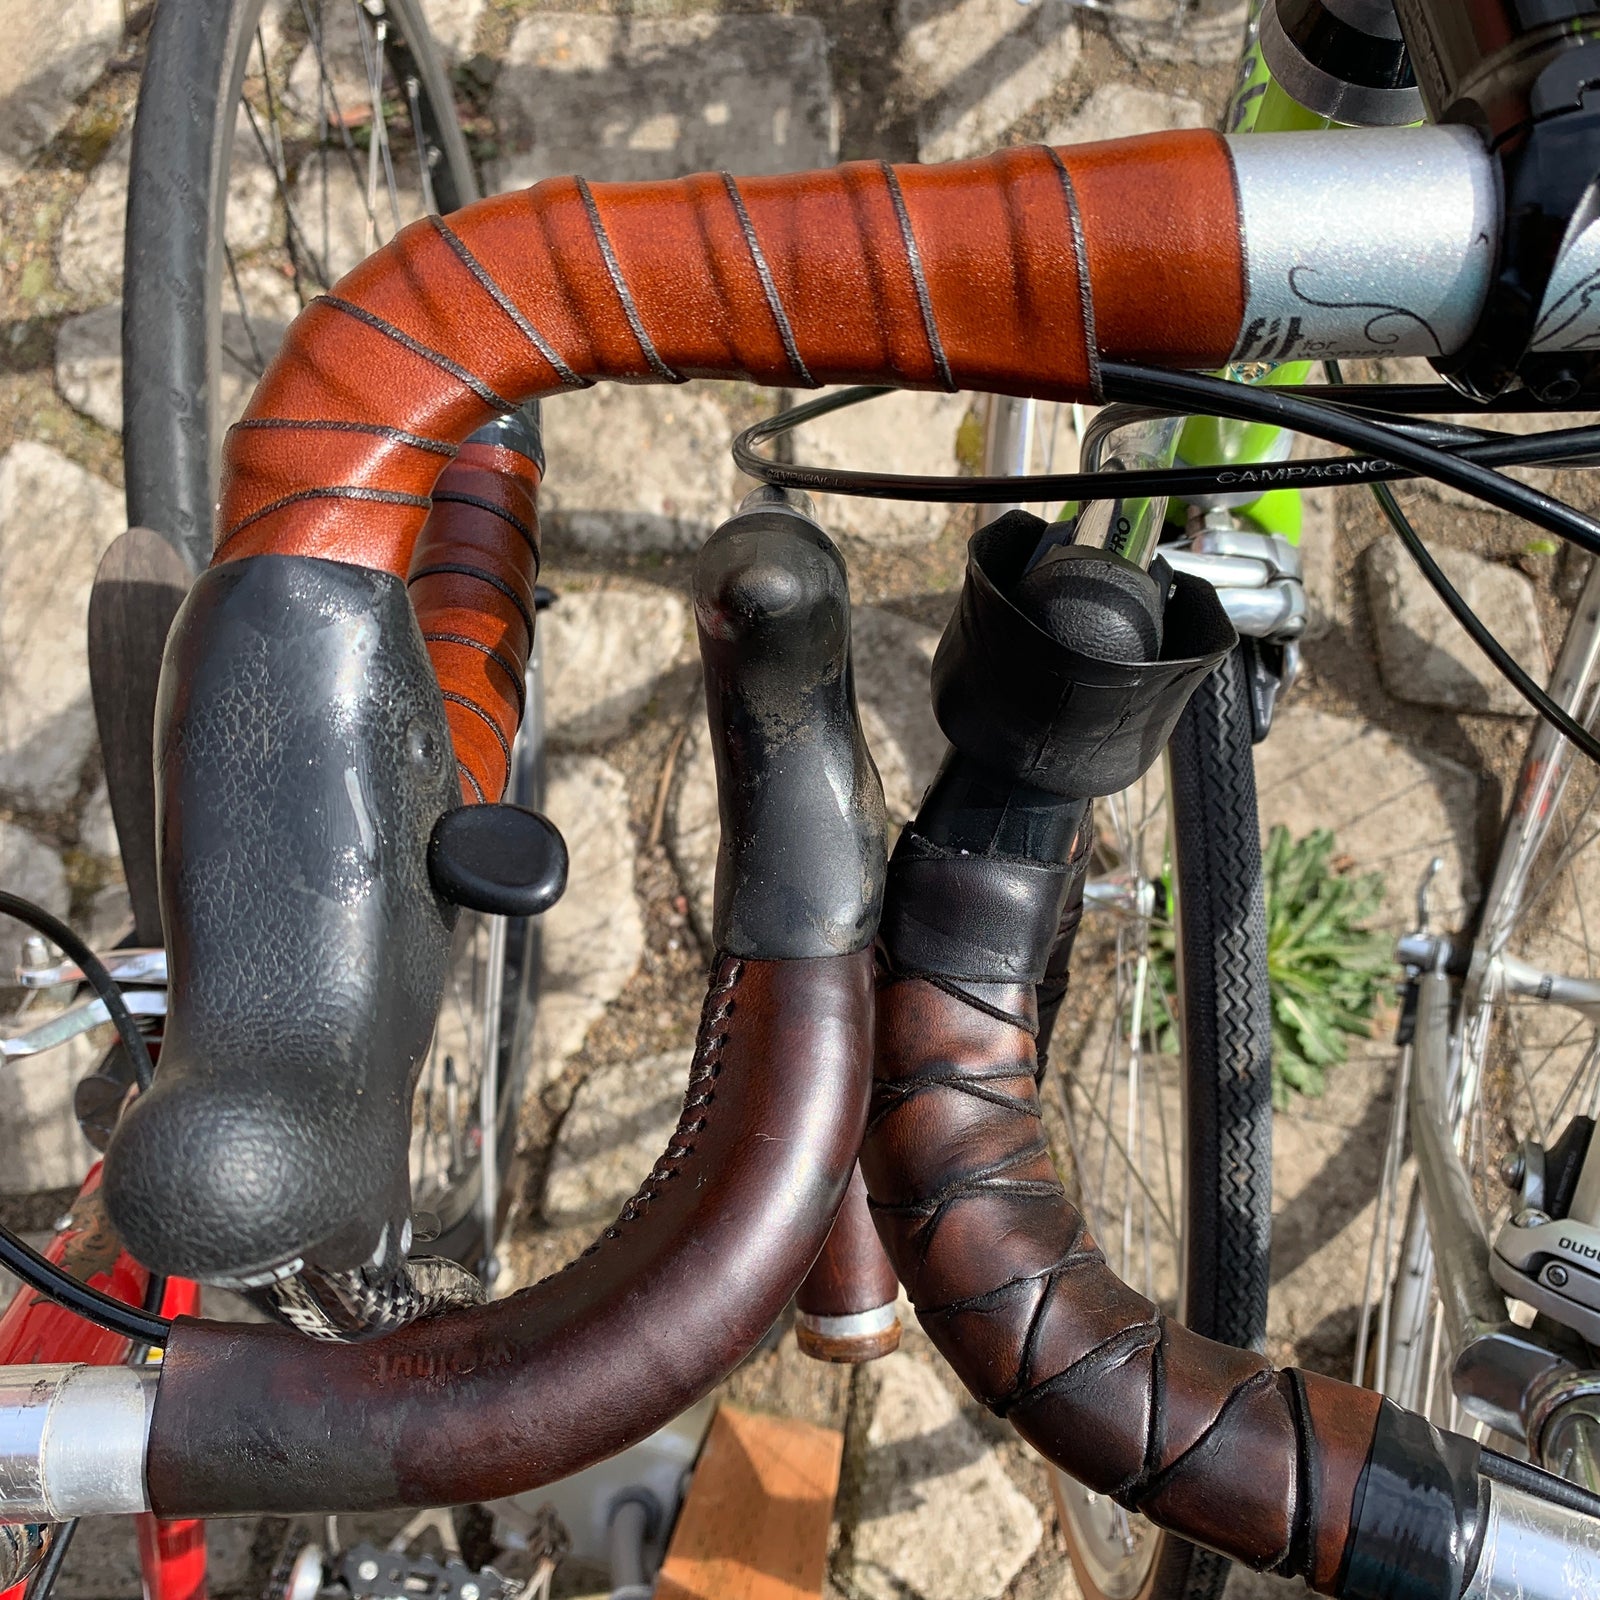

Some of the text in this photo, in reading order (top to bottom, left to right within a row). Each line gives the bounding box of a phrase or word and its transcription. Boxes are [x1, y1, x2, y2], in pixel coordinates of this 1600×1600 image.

[1231, 316, 1338, 360] fit for
[1558, 1237, 1600, 1262] ANO
